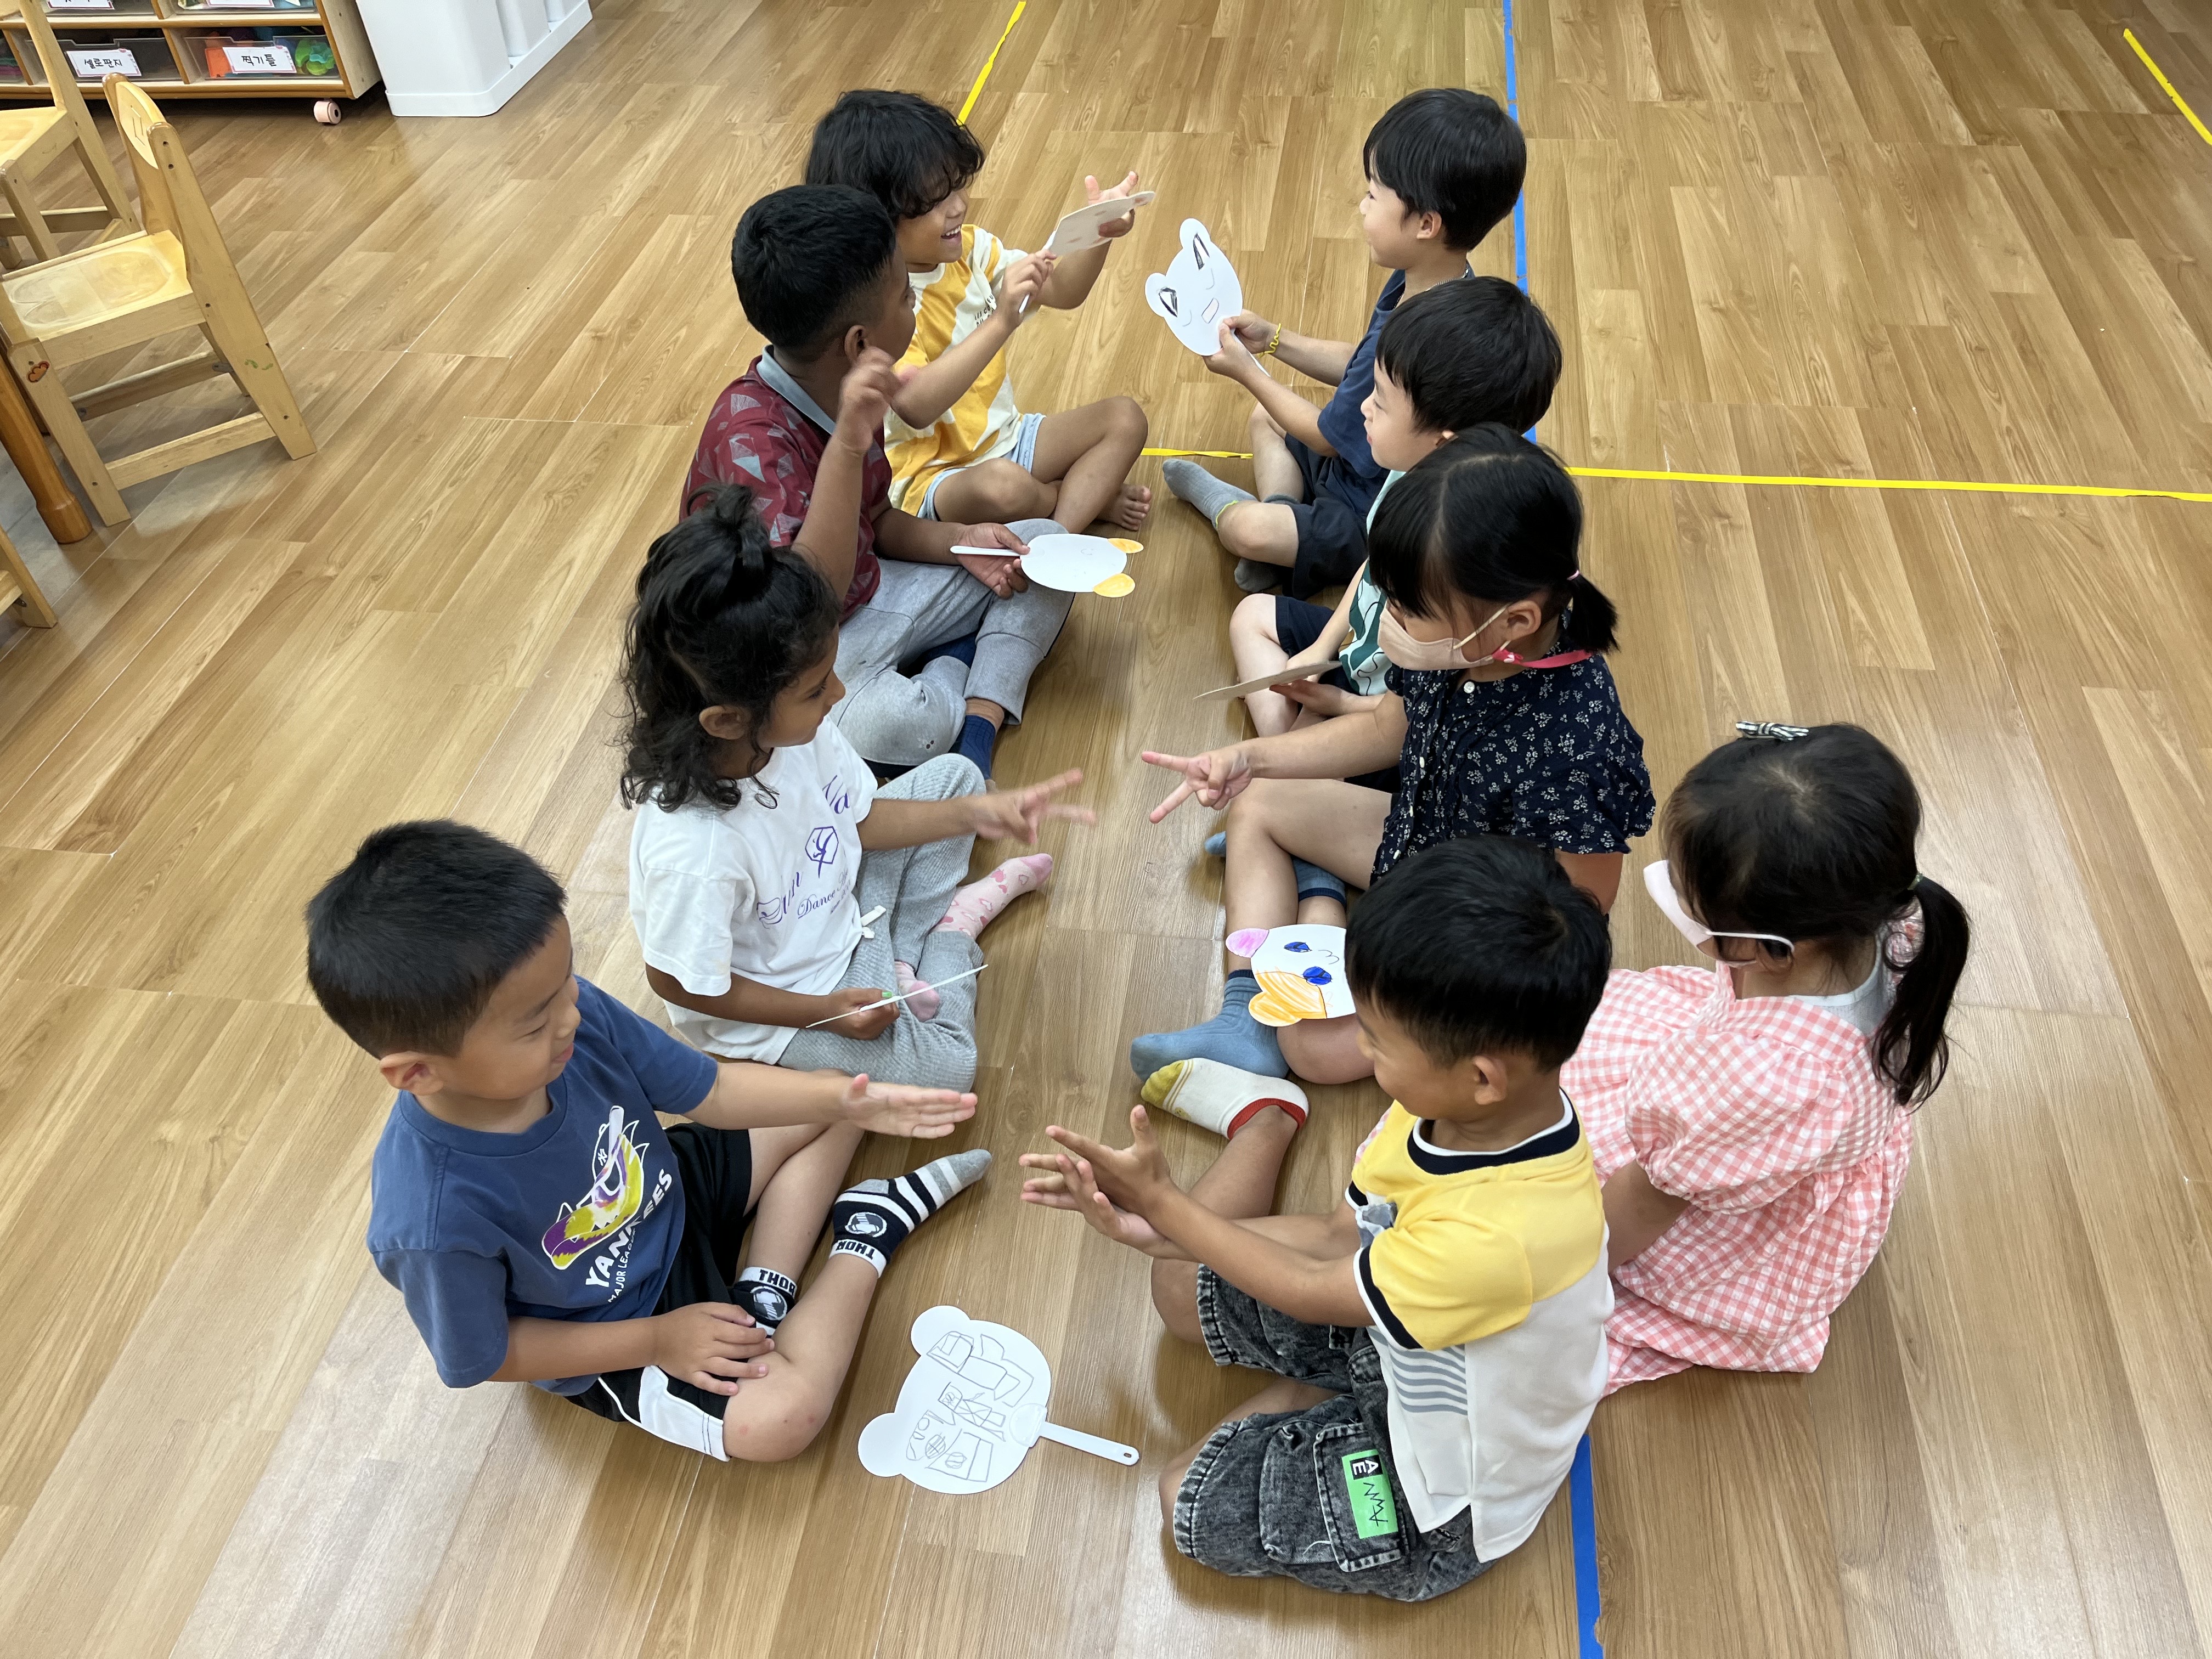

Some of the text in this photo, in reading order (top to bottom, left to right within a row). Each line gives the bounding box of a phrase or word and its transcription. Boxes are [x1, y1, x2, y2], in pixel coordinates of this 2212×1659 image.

[84, 58, 123, 69] 셀로판지
[241, 54, 277, 67] 찍기틀
[797, 890, 836, 919] Dance
[585, 1169, 672, 1288] YANKEES
[835, 1240, 875, 1261] THOR
[607, 1270, 627, 1303] MAJOR
